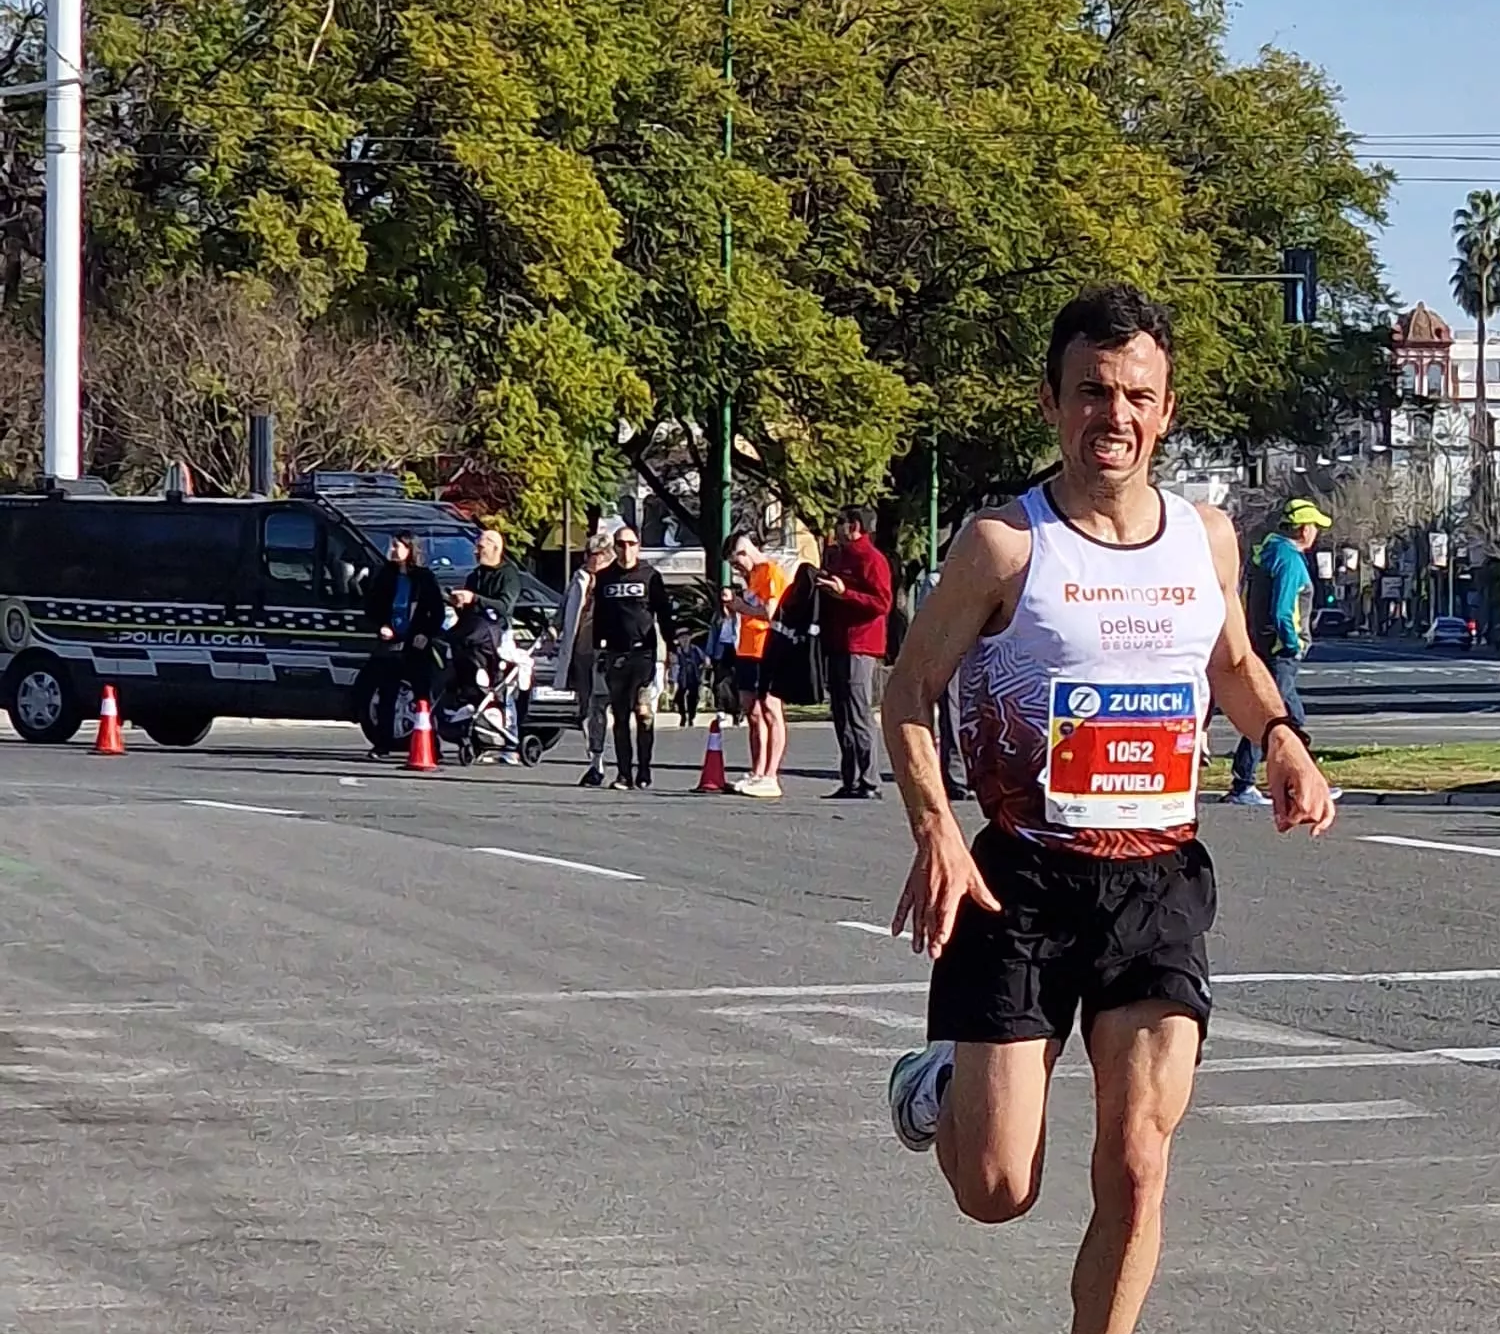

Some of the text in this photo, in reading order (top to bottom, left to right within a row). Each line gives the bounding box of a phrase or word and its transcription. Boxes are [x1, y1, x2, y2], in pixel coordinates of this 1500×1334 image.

[1064, 582, 1197, 606] Runningzgz
[118, 629, 265, 646] POLICÍA LOCAL
[1108, 692, 1183, 712] ZURICH
[1105, 740, 1155, 763] 1052
[1090, 773, 1166, 792] PUYUELO
